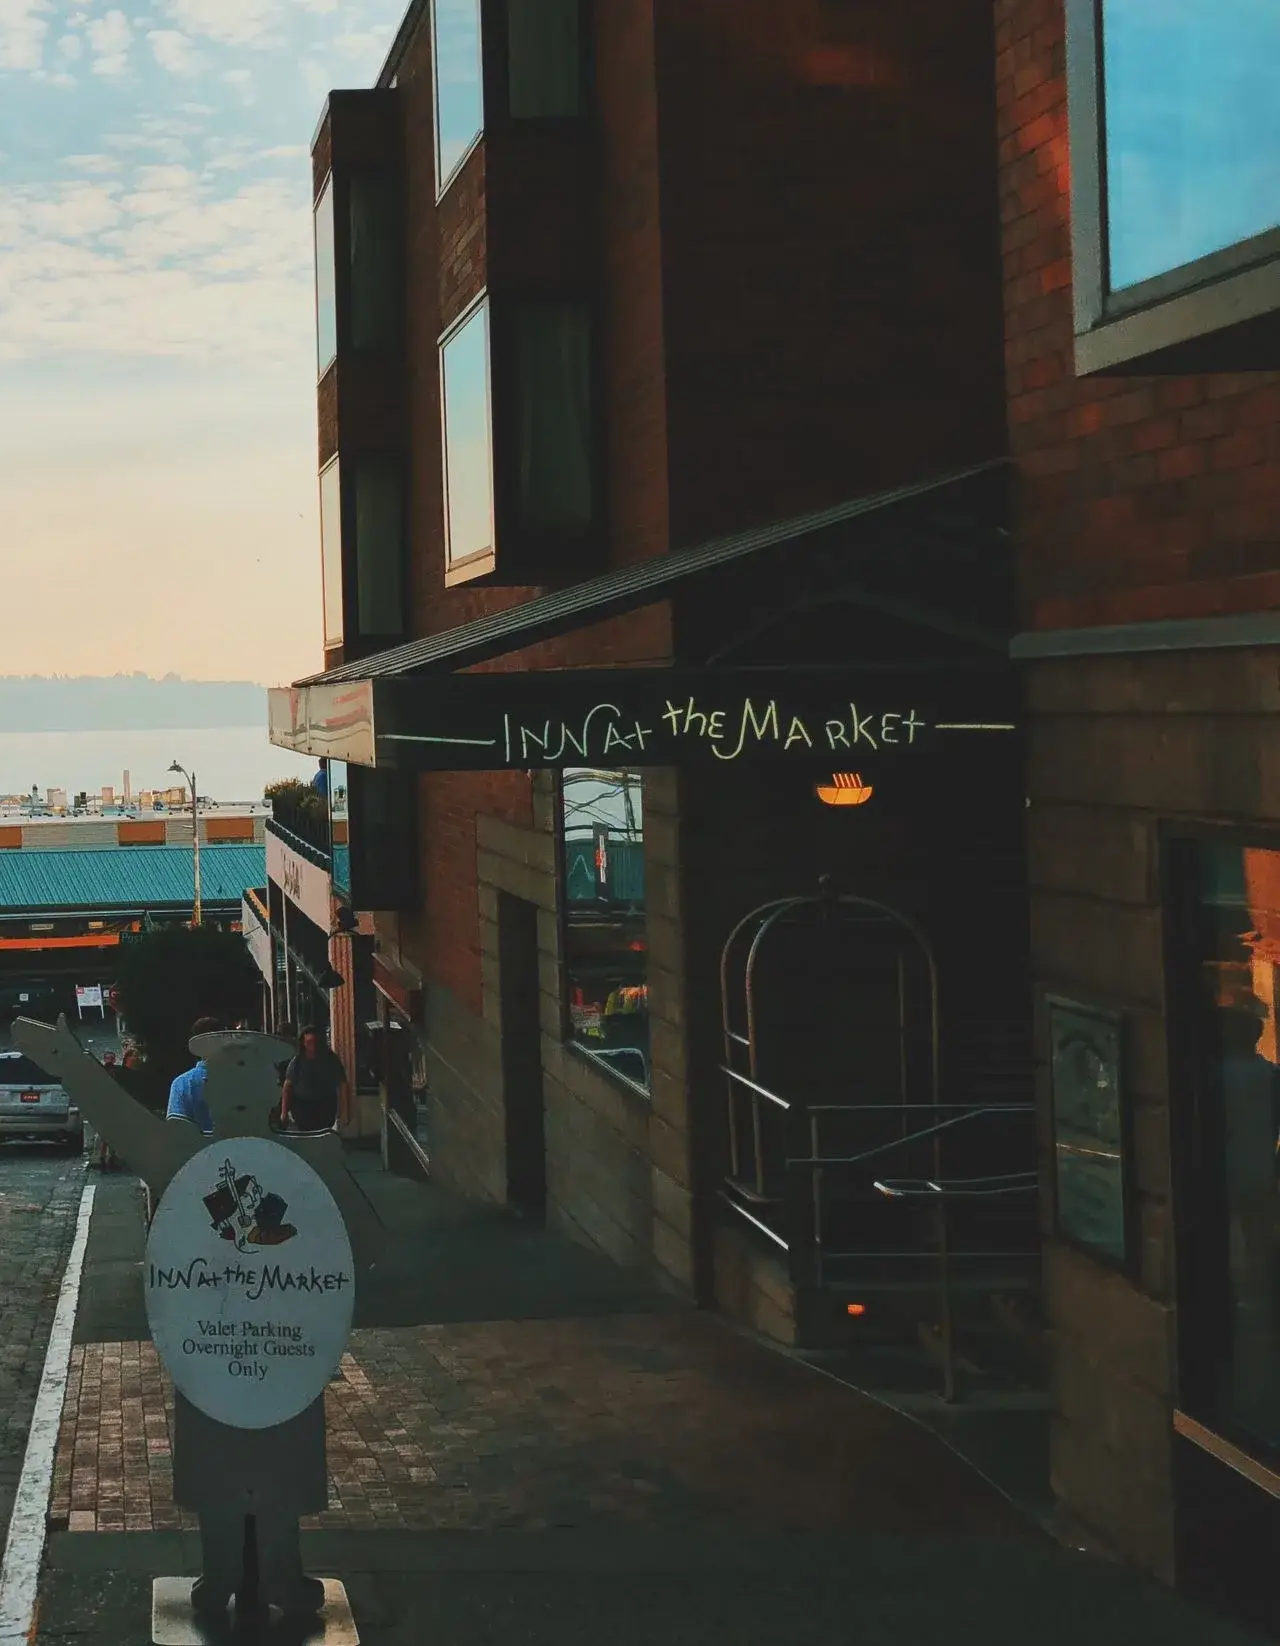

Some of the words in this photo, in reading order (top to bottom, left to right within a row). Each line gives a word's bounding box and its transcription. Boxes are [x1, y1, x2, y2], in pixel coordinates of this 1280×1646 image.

[197, 1320, 236, 1336] Valet
[242, 1321, 303, 1342] Parking
[182, 1338, 258, 1359] Overnight
[263, 1340, 316, 1356] Guests
[228, 1360, 269, 1381] Only
